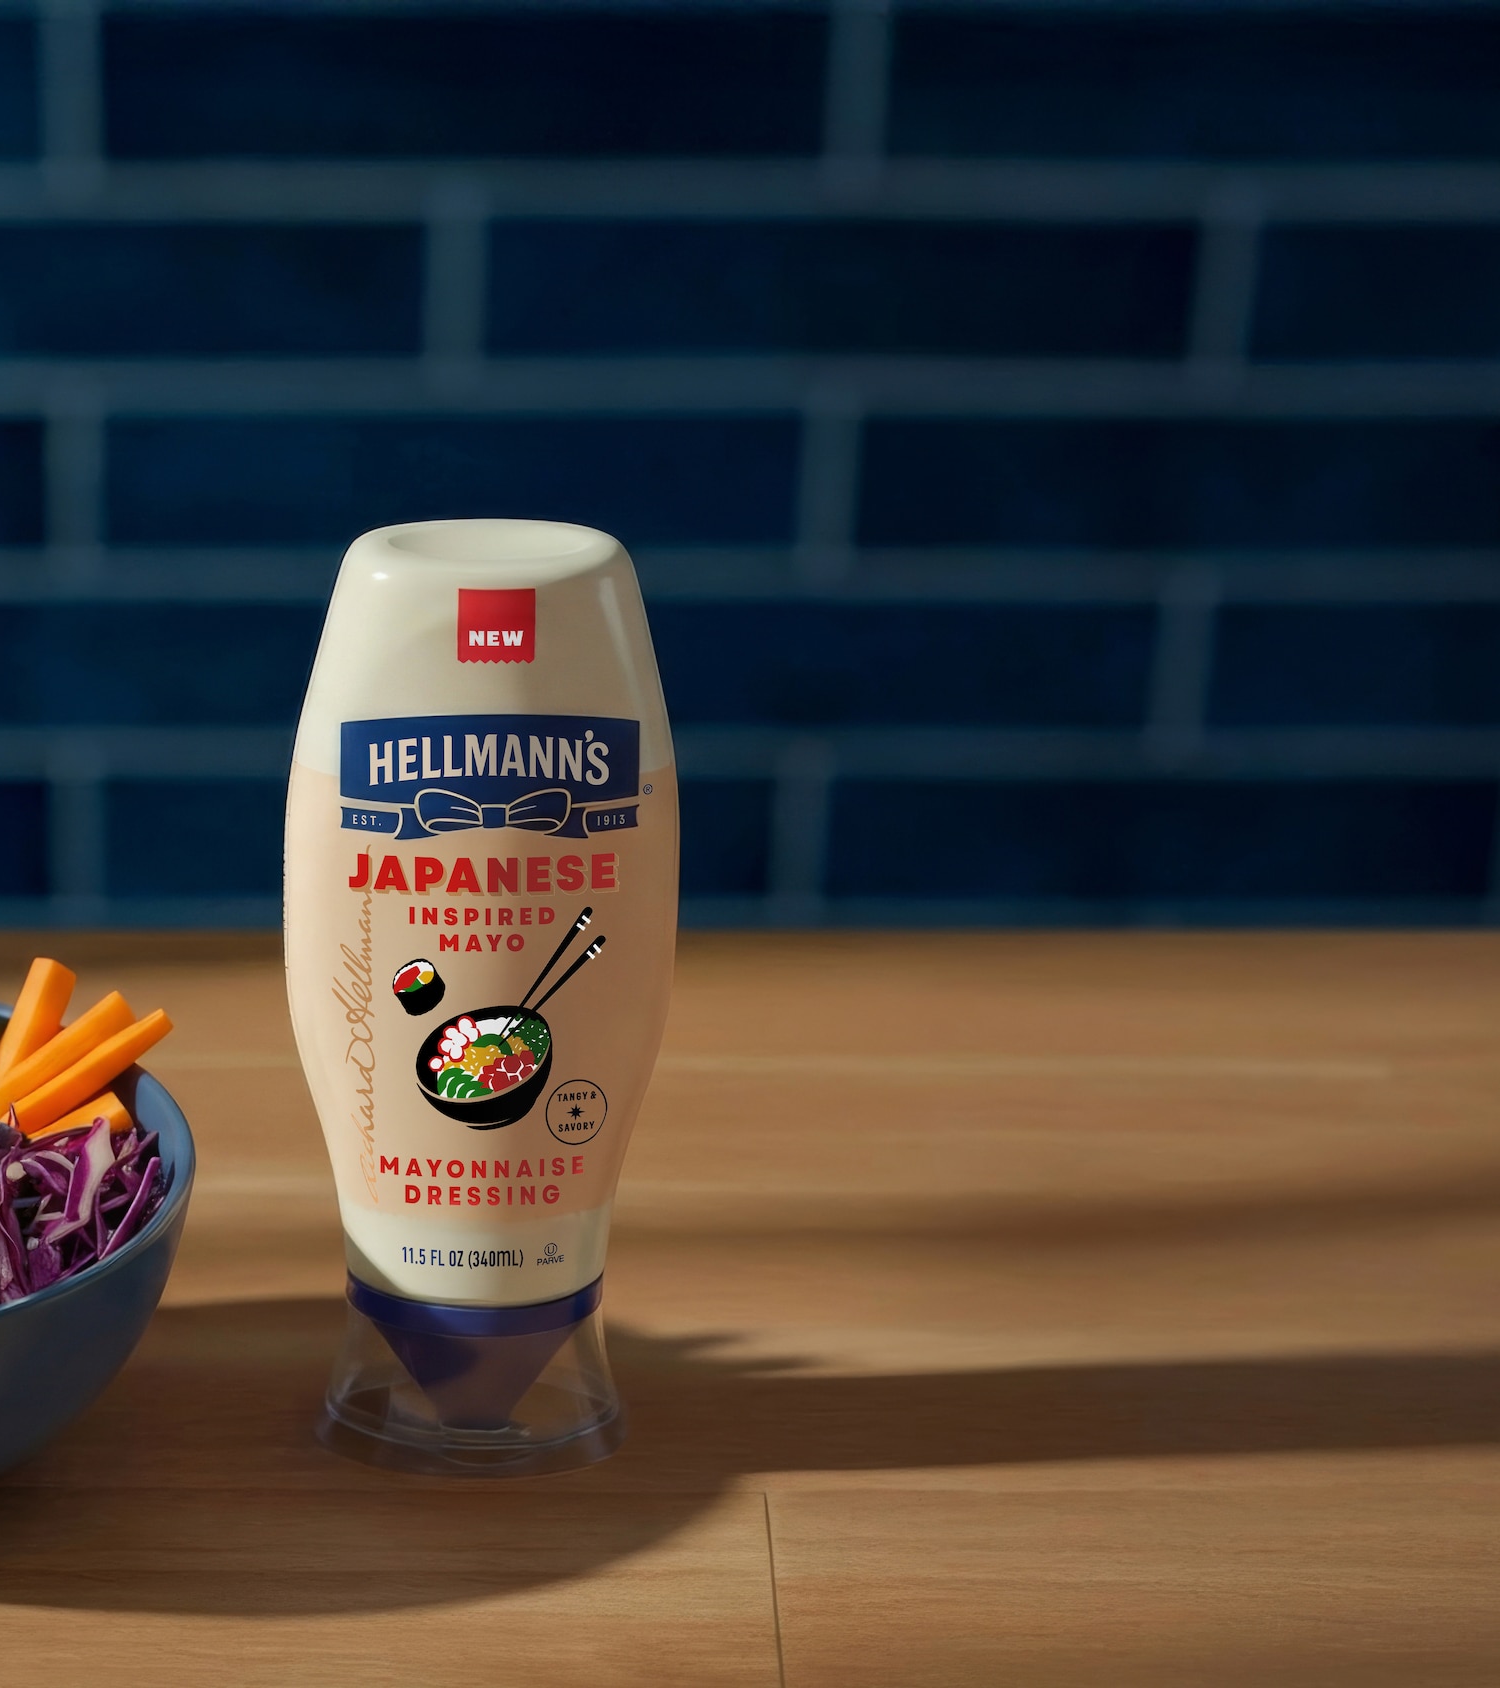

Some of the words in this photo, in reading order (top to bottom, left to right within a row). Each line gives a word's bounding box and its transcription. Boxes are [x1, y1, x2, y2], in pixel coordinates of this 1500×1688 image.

[468, 630, 524, 647] NEW
[368, 729, 610, 787] HELLMANN'S
[352, 814, 382, 826] EST.
[596, 814, 626, 826] 1913
[348, 853, 618, 896] JAPANESE
[408, 906, 556, 926] INSPIRED
[438, 933, 525, 952] MAYO
[557, 1091, 588, 1102] TANGY
[590, 1091, 597, 1099] &
[558, 1121, 595, 1133] SAVORY
[379, 1155, 585, 1179] MAYONNAISE
[404, 1184, 560, 1206] DRESSING
[401, 1246, 426, 1265] 11.5
[430, 1250, 445, 1267] FL
[449, 1250, 464, 1267] OZ
[468, 1249, 524, 1270] (340mL)
[536, 1255, 565, 1266] PARVE
